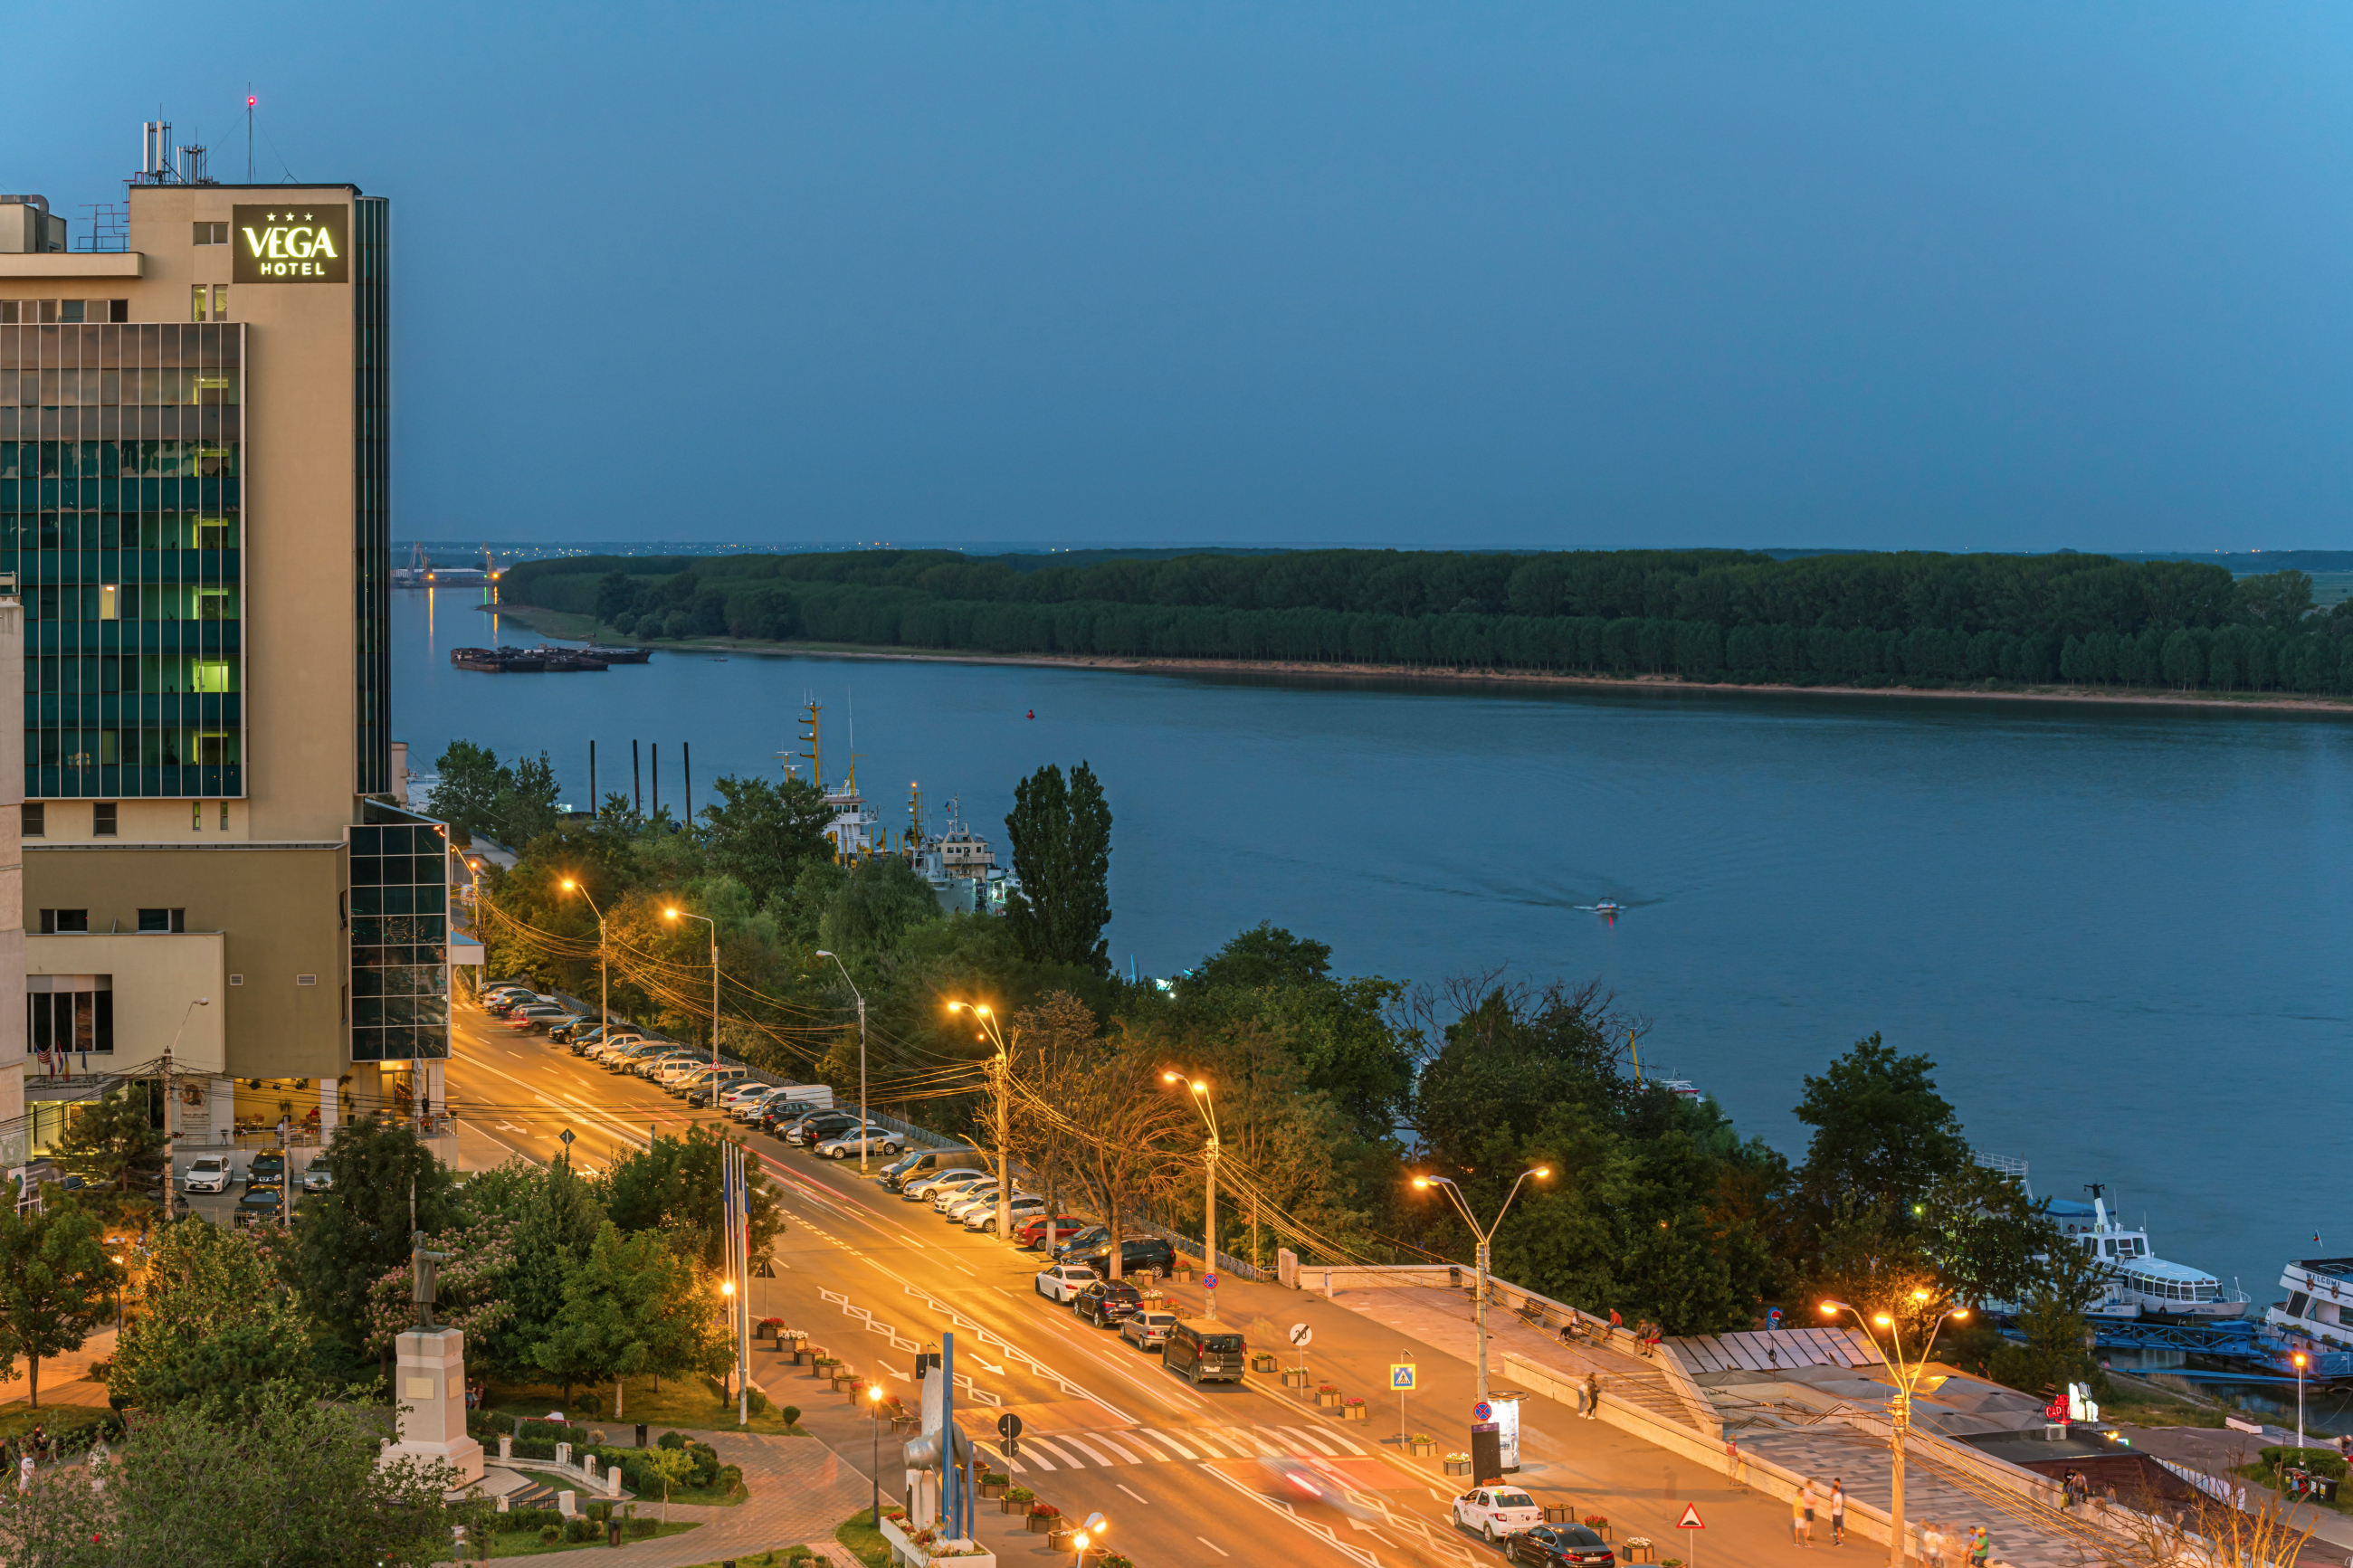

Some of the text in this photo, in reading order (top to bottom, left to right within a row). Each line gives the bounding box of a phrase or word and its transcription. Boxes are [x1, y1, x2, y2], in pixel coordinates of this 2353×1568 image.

[242, 227, 338, 258] VEGA
[261, 262, 325, 275] HOTEL
[2306, 1272, 2341, 1288] WELCOME
